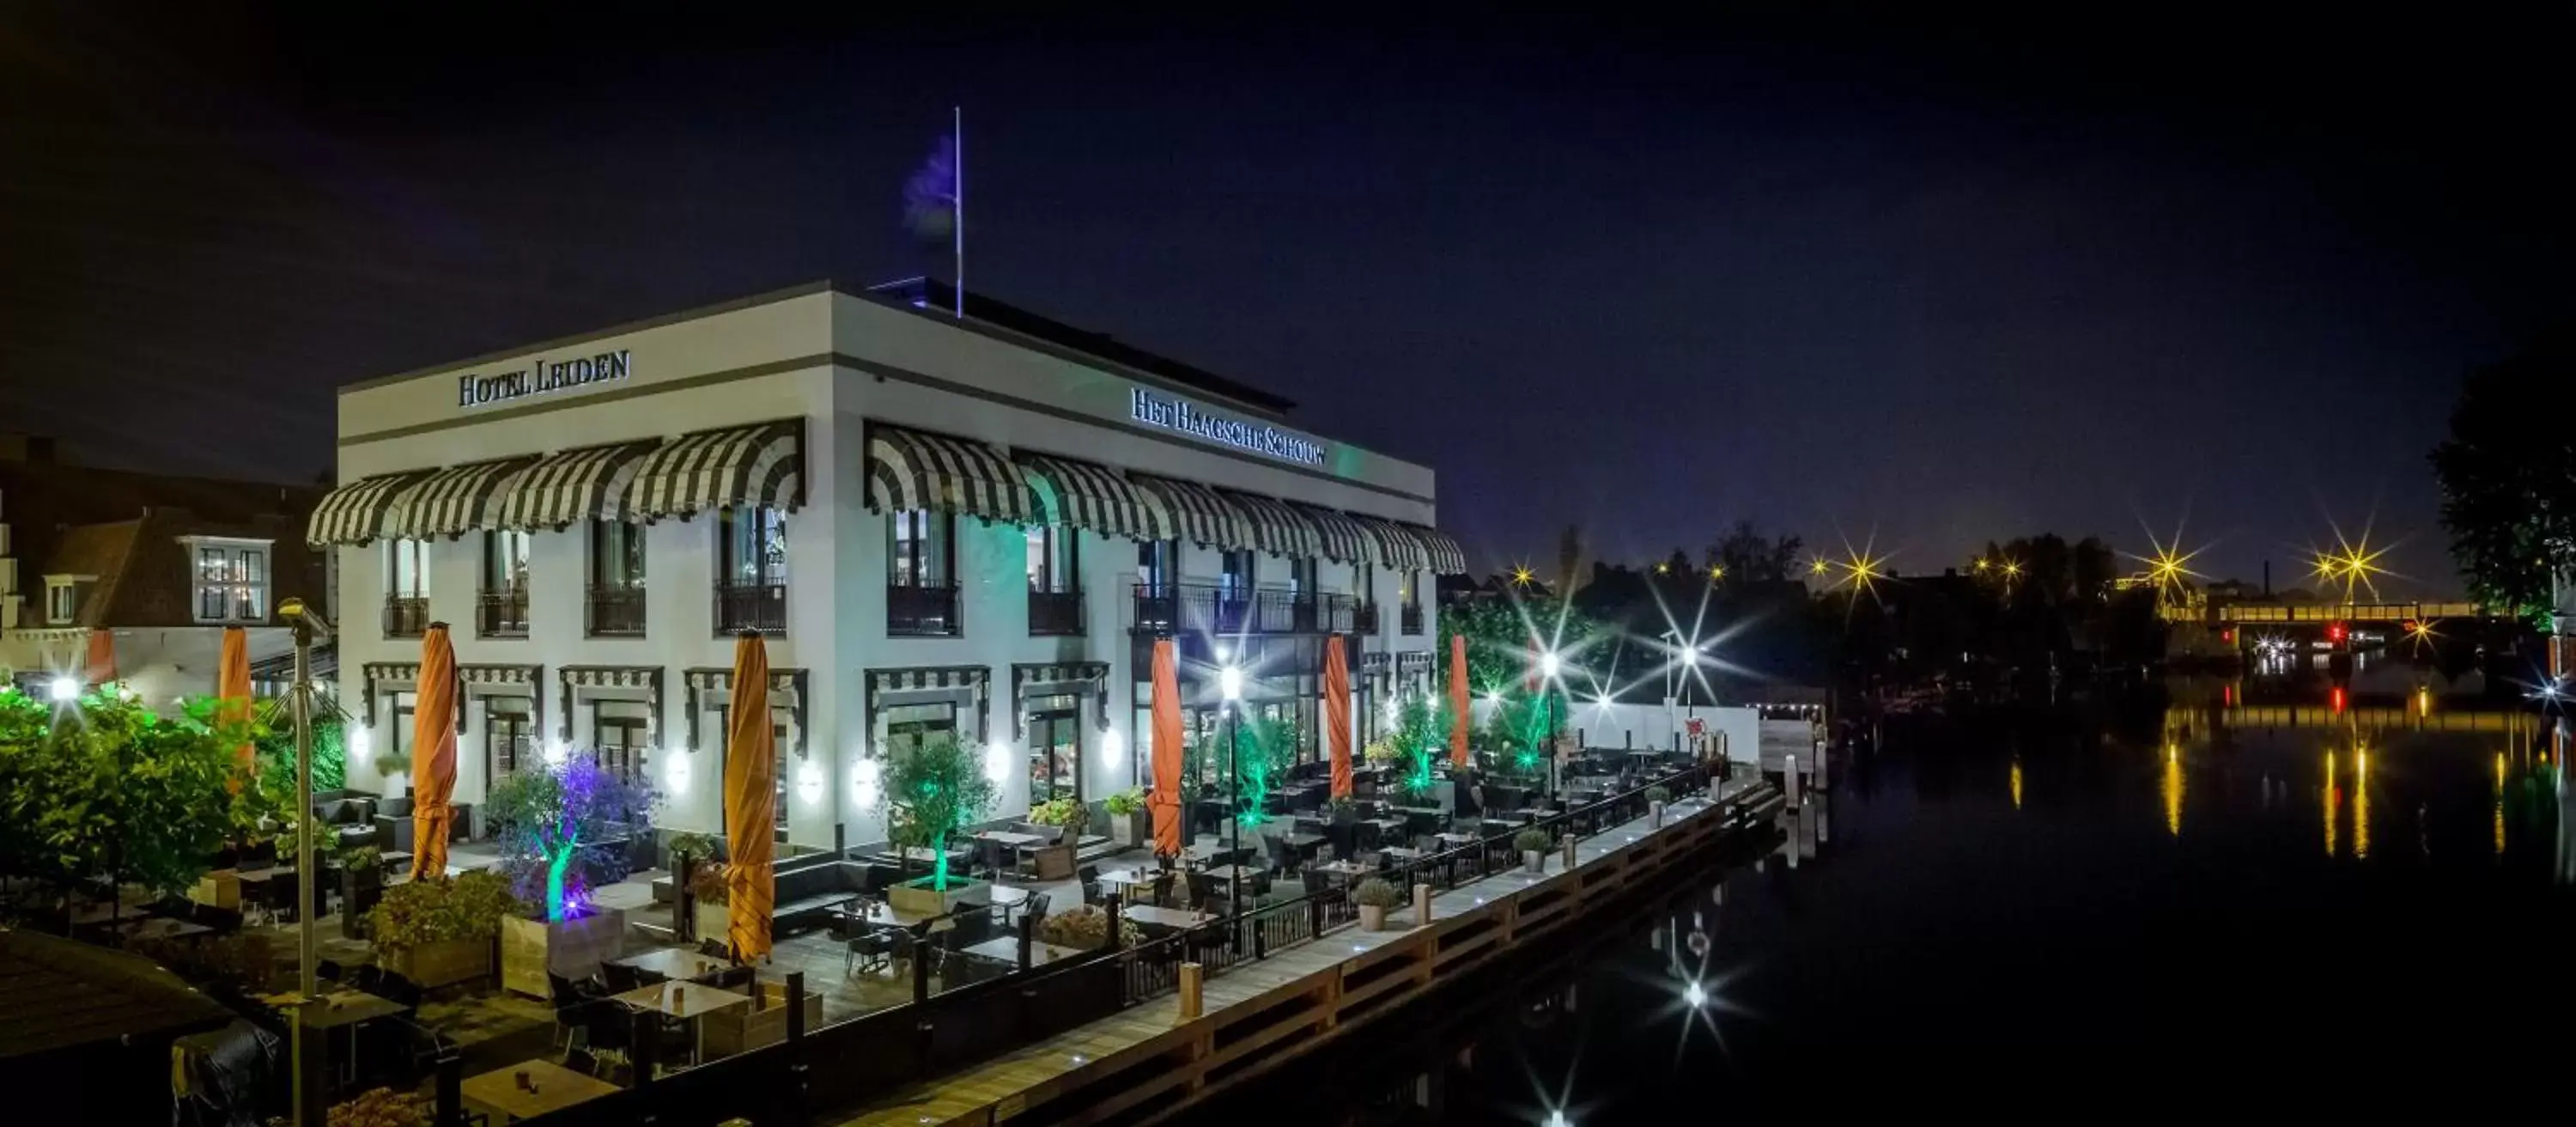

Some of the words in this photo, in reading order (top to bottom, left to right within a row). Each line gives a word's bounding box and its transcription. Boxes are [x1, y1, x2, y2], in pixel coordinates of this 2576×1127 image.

[459, 370, 532, 407] HOTEL
[535, 350, 630, 393] LEIDEN
[1131, 387, 1174, 427] HET
[1175, 400, 1265, 452] HAAGSCHE
[1266, 427, 1327, 466] SCHOUW
